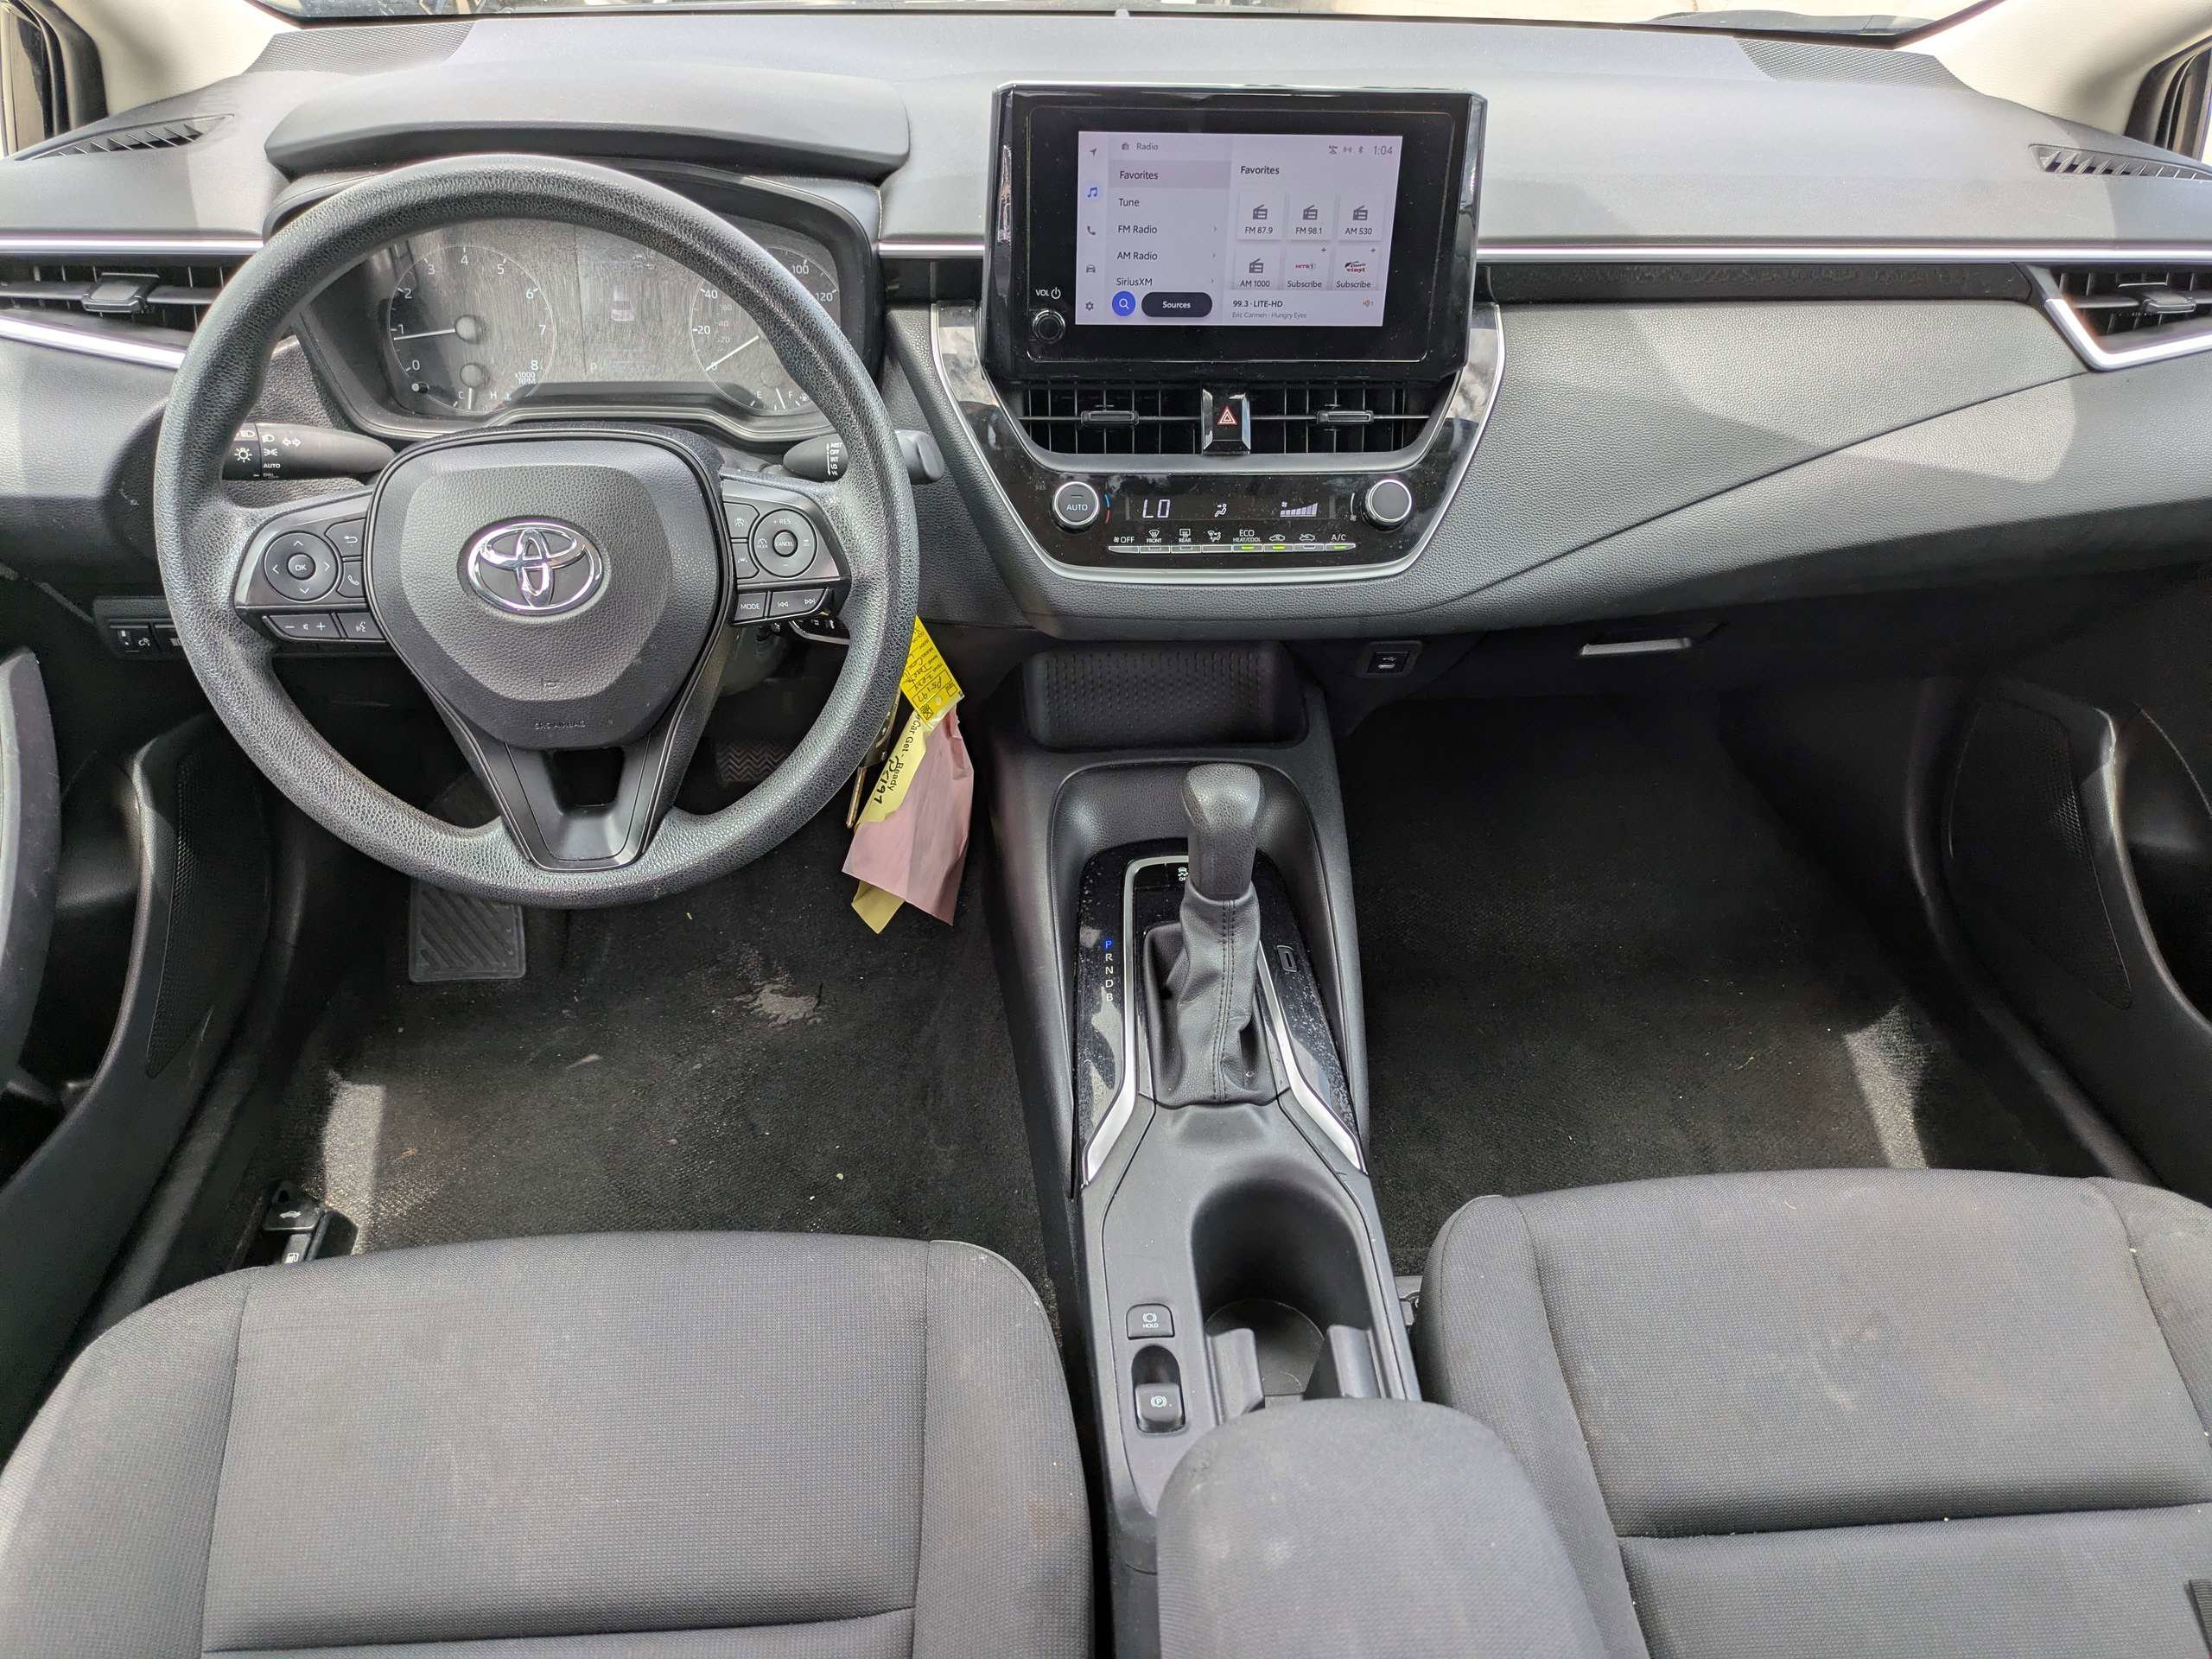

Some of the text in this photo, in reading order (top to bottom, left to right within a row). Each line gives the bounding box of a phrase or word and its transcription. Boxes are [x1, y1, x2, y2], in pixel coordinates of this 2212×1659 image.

[1374, 146, 1393, 155] 1:04
[1119, 170, 1159, 180] Favorites
[1240, 166, 1280, 175] Favorites
[1119, 198, 1140, 207] Tune
[1133, 225, 1158, 234] Radio
[461, 255, 469, 265] 4
[1116, 251, 1158, 260] AM Radio
[428, 264, 435, 275] 3
[497, 264, 505, 274] 5
[792, 264, 810, 275] 100
[1116, 277, 1153, 286] SiriusXM
[404, 288, 413, 299] 2
[526, 289, 534, 299] 6
[705, 289, 718, 299] 40
[816, 292, 833, 302] 120
[397, 324, 404, 334] 1
[538, 324, 546, 335] 7
[697, 326, 711, 334] 20
[412, 359, 421, 371] 0
[531, 360, 539, 371] 8
[1142, 499, 1171, 518] LO
[910, 720, 922, 734] Car
[901, 736, 914, 753] Get
[1105, 940, 1112, 949] P
[1105, 953, 1114, 962] R
[1105, 965, 1114, 975] N
[1105, 979, 1114, 988] D
[1106, 993, 1114, 1001] B
